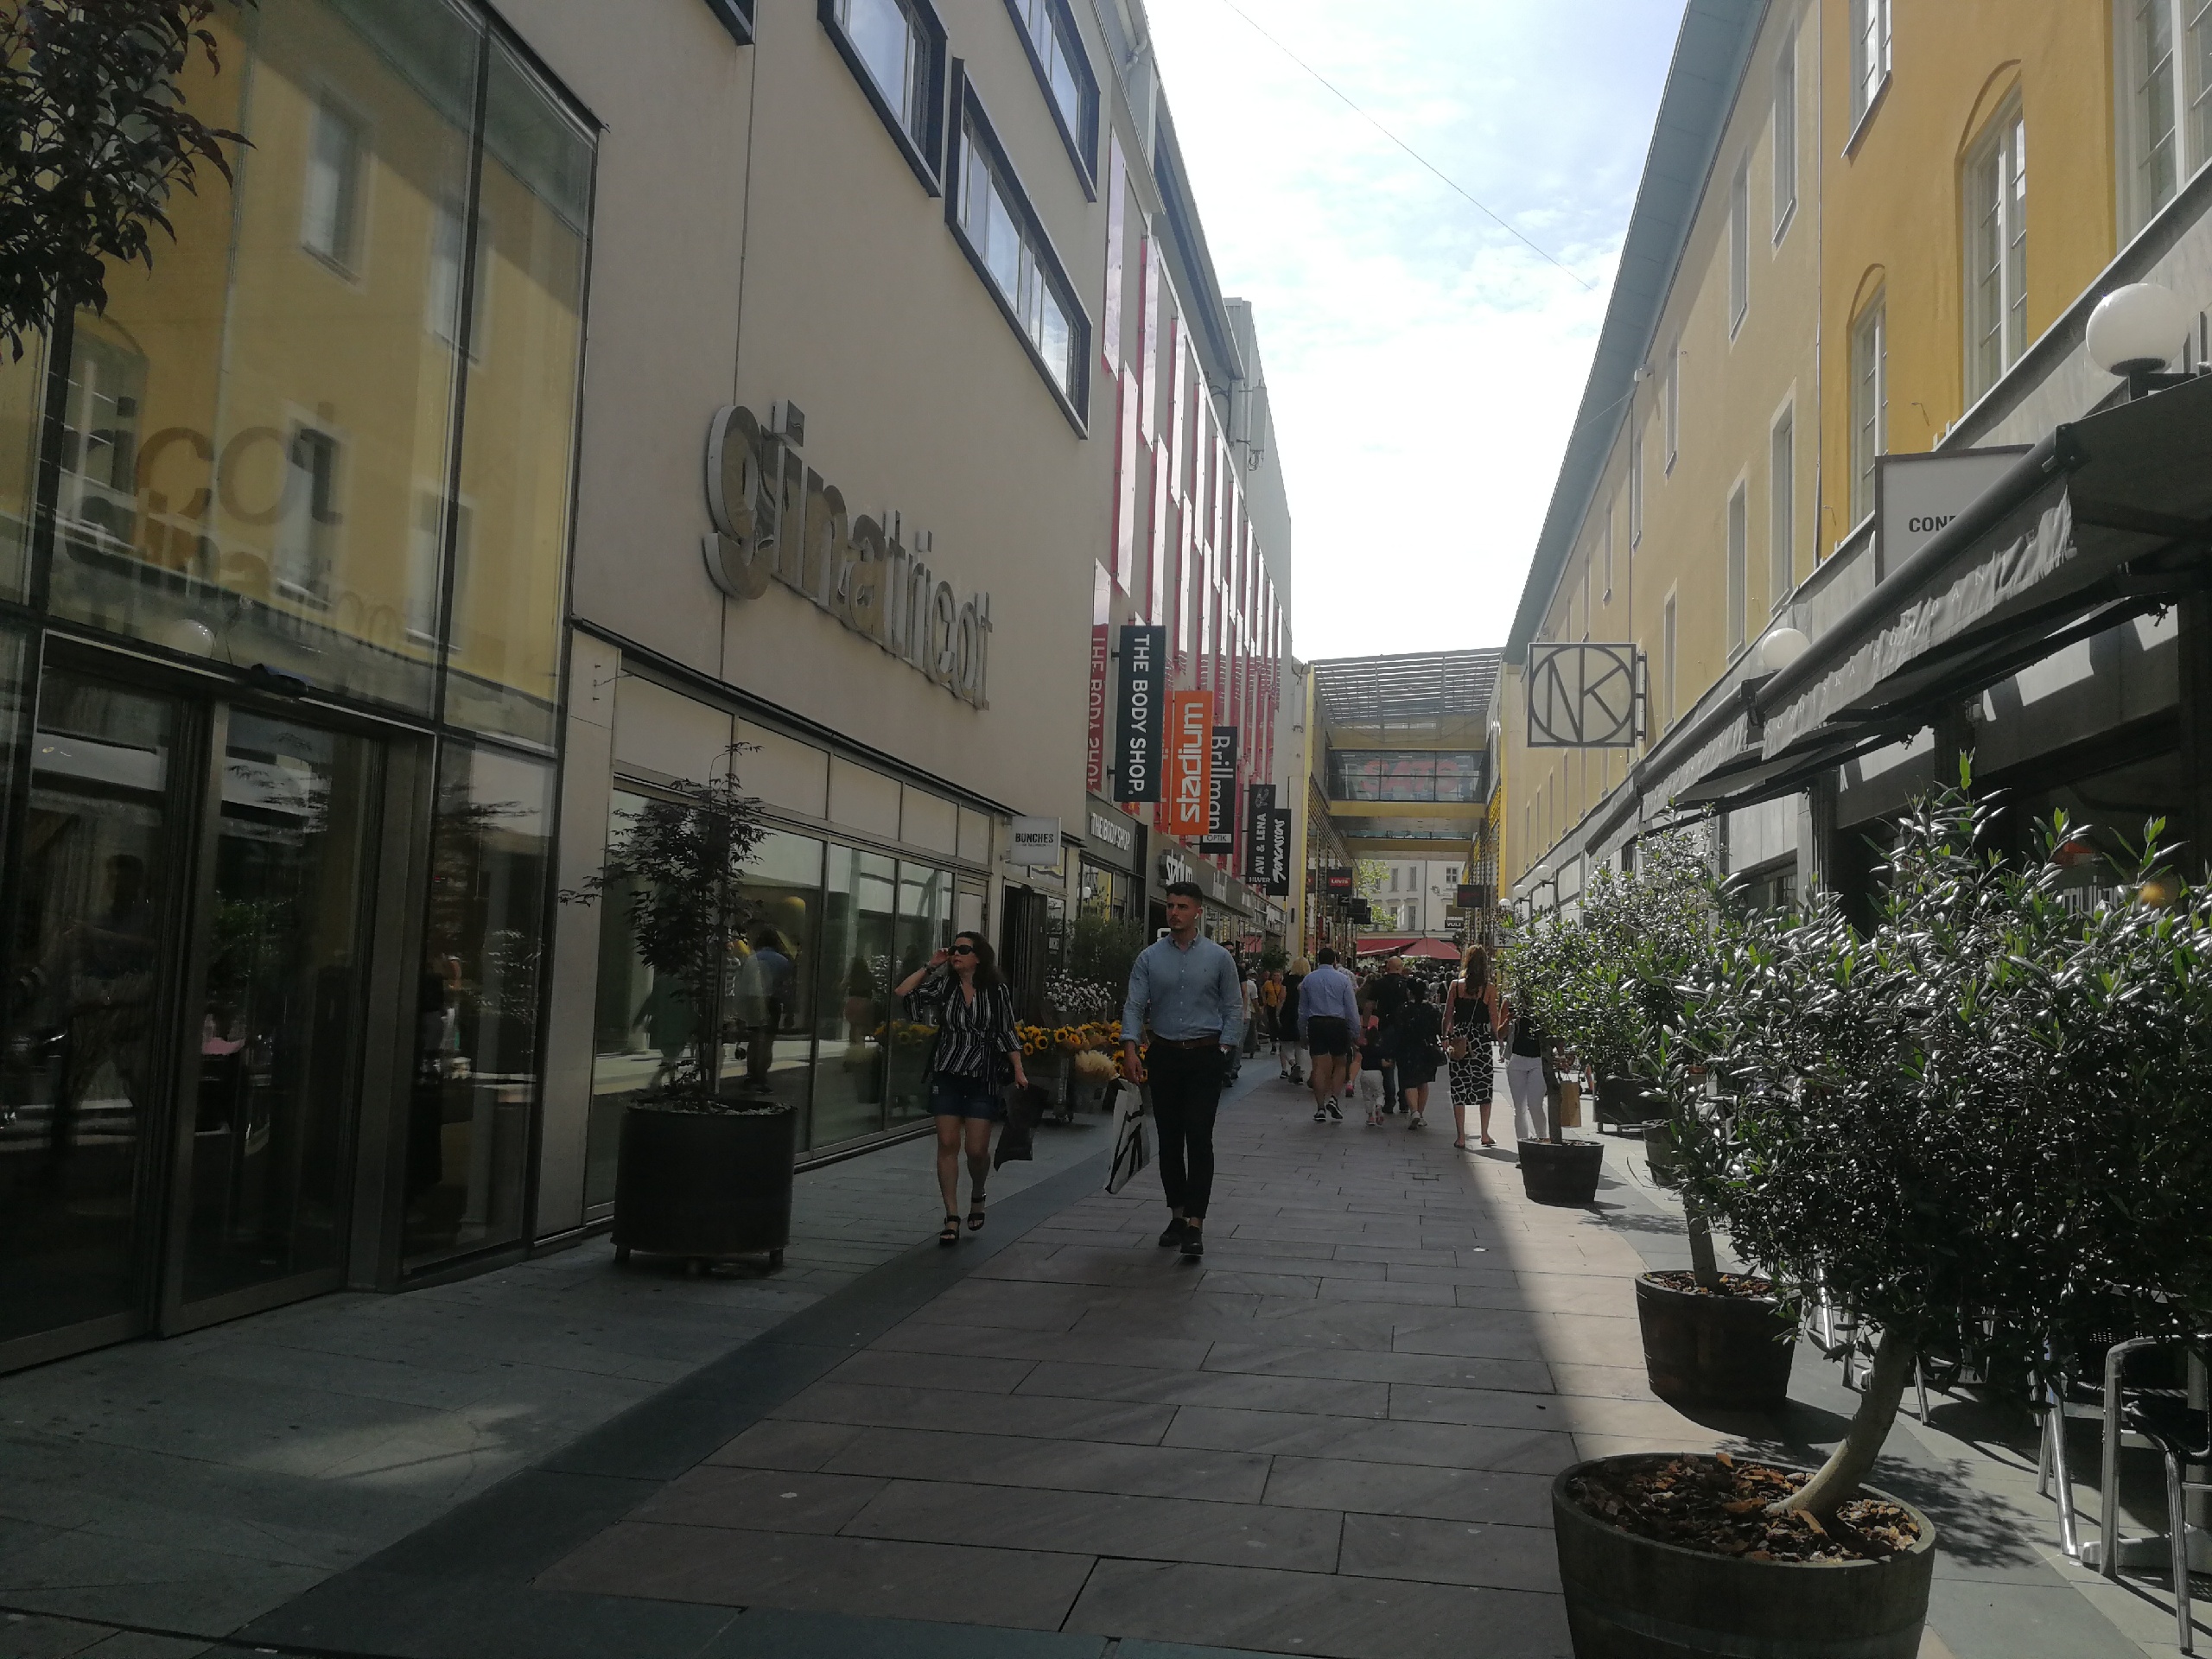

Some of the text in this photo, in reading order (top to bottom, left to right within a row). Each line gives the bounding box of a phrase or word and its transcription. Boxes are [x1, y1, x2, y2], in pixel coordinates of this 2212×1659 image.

[1133, 633, 1150, 673] THE
[1130, 679, 1148, 734] BODY
[1543, 645, 1626, 744] NK
[1176, 702, 1204, 823] stadium
[1209, 734, 1234, 831] Brillman
[1014, 832, 1054, 843] BUNCHES
[1090, 812, 1131, 851] THE BODY SHOP
[1255, 812, 1267, 875] AVI & LENA
